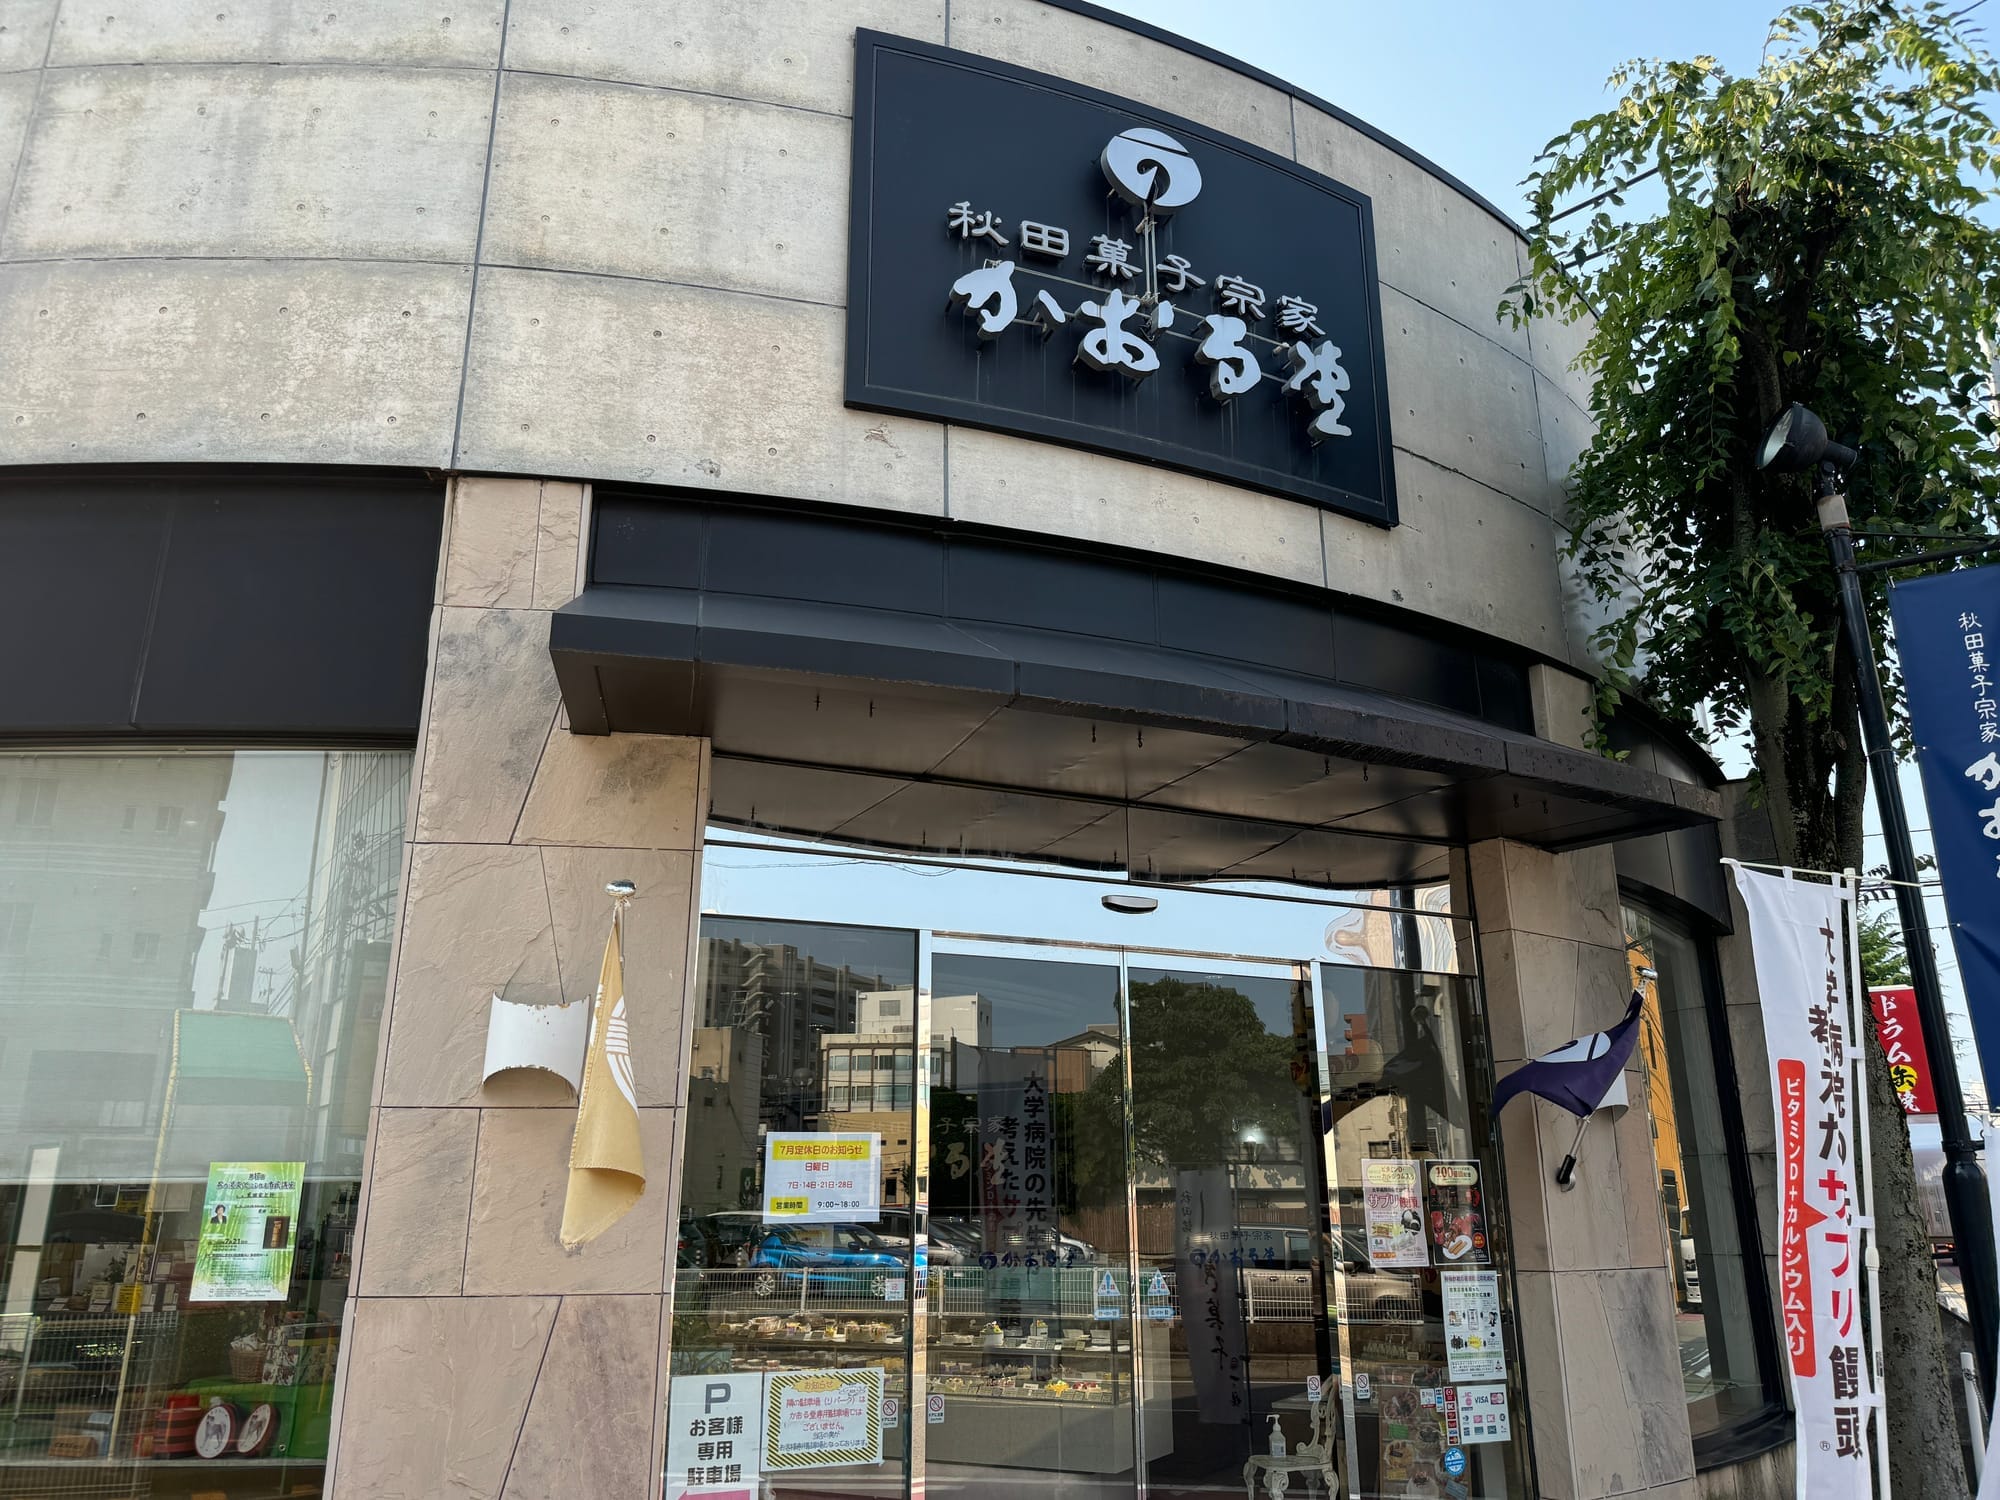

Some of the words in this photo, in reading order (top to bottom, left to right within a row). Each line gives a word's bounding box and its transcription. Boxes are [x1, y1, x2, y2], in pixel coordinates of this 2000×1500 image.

[946, 200, 1327, 339] 秋田菓子宗家
[1958, 611, 2000, 744] 秋田菓子宗家
[779, 1145, 863, 1155] 7月定休日のお知らせ
[804, 1162, 829, 1171] 日曜日
[804, 1380, 834, 1390] お知らせ
[704, 1383, 731, 1414] P
[1474, 1396, 1489, 1404] VISA
[690, 1416, 743, 1437] お客様
[697, 1440, 733, 1461] 専用
[687, 1464, 742, 1486] 駐車場
